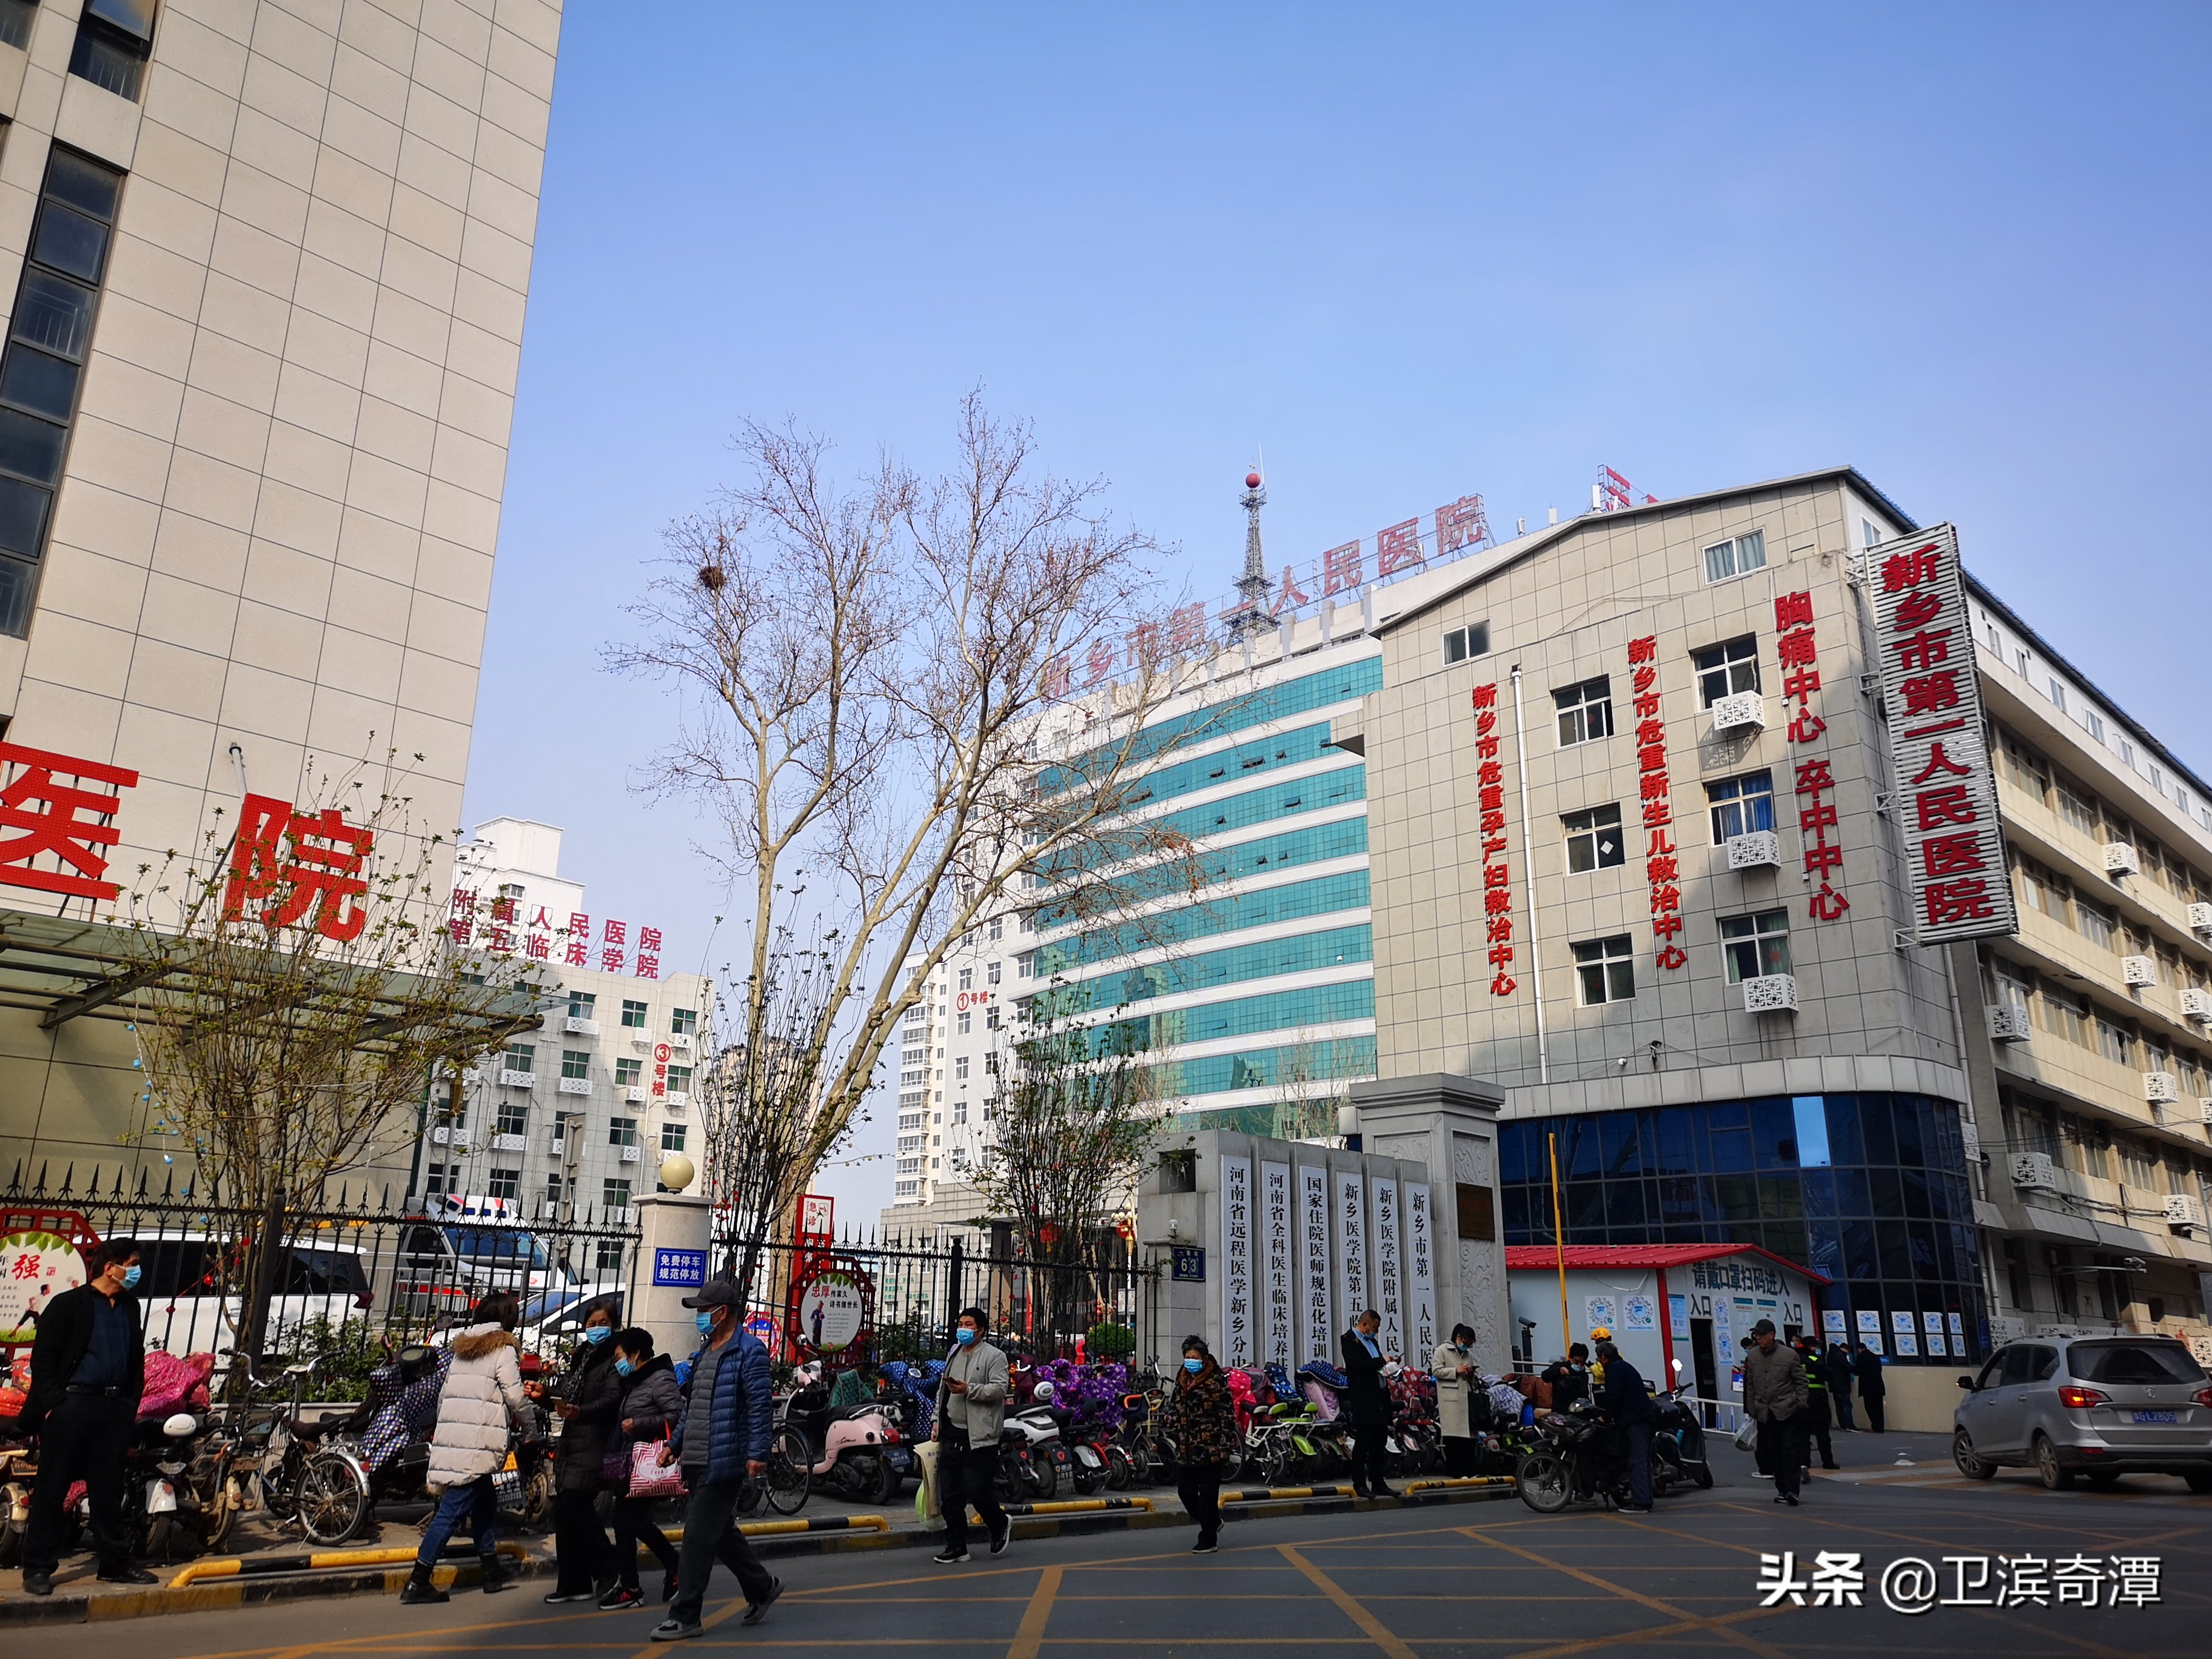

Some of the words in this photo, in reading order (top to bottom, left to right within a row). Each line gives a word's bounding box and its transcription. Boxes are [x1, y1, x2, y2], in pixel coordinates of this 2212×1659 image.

[1775, 591, 1826, 743] 胸痛中心
[1881, 543, 1993, 925] 新乡市第一人民医院
[0, 740, 375, 942] 医院
[1472, 682, 1517, 996] 新乡市危重孕产妇救治中心
[1628, 634, 1687, 970] 新乡市危重新生儿救治中心
[1795, 760, 1849, 920] 卒中中心
[448, 917, 659, 980] 第五临床学院
[452, 888, 662, 952] 附属人民医院
[11, 1253, 41, 1281] 强
[659, 1267, 700, 1281] 规范停放
[660, 1254, 701, 1267] 免费停车
[1307, 1176, 1327, 1363] 国家住院医师规范化培训
[1379, 1187, 1399, 1357] 新乡医学院附属人民
[1412, 1191, 1432, 1369] 新乡市第一人民医
[1690, 1293, 1712, 1317] 入口
[1692, 1261, 1791, 1297] 请戴口罩扫码进入
[1783, 1301, 1803, 1324] 入口
